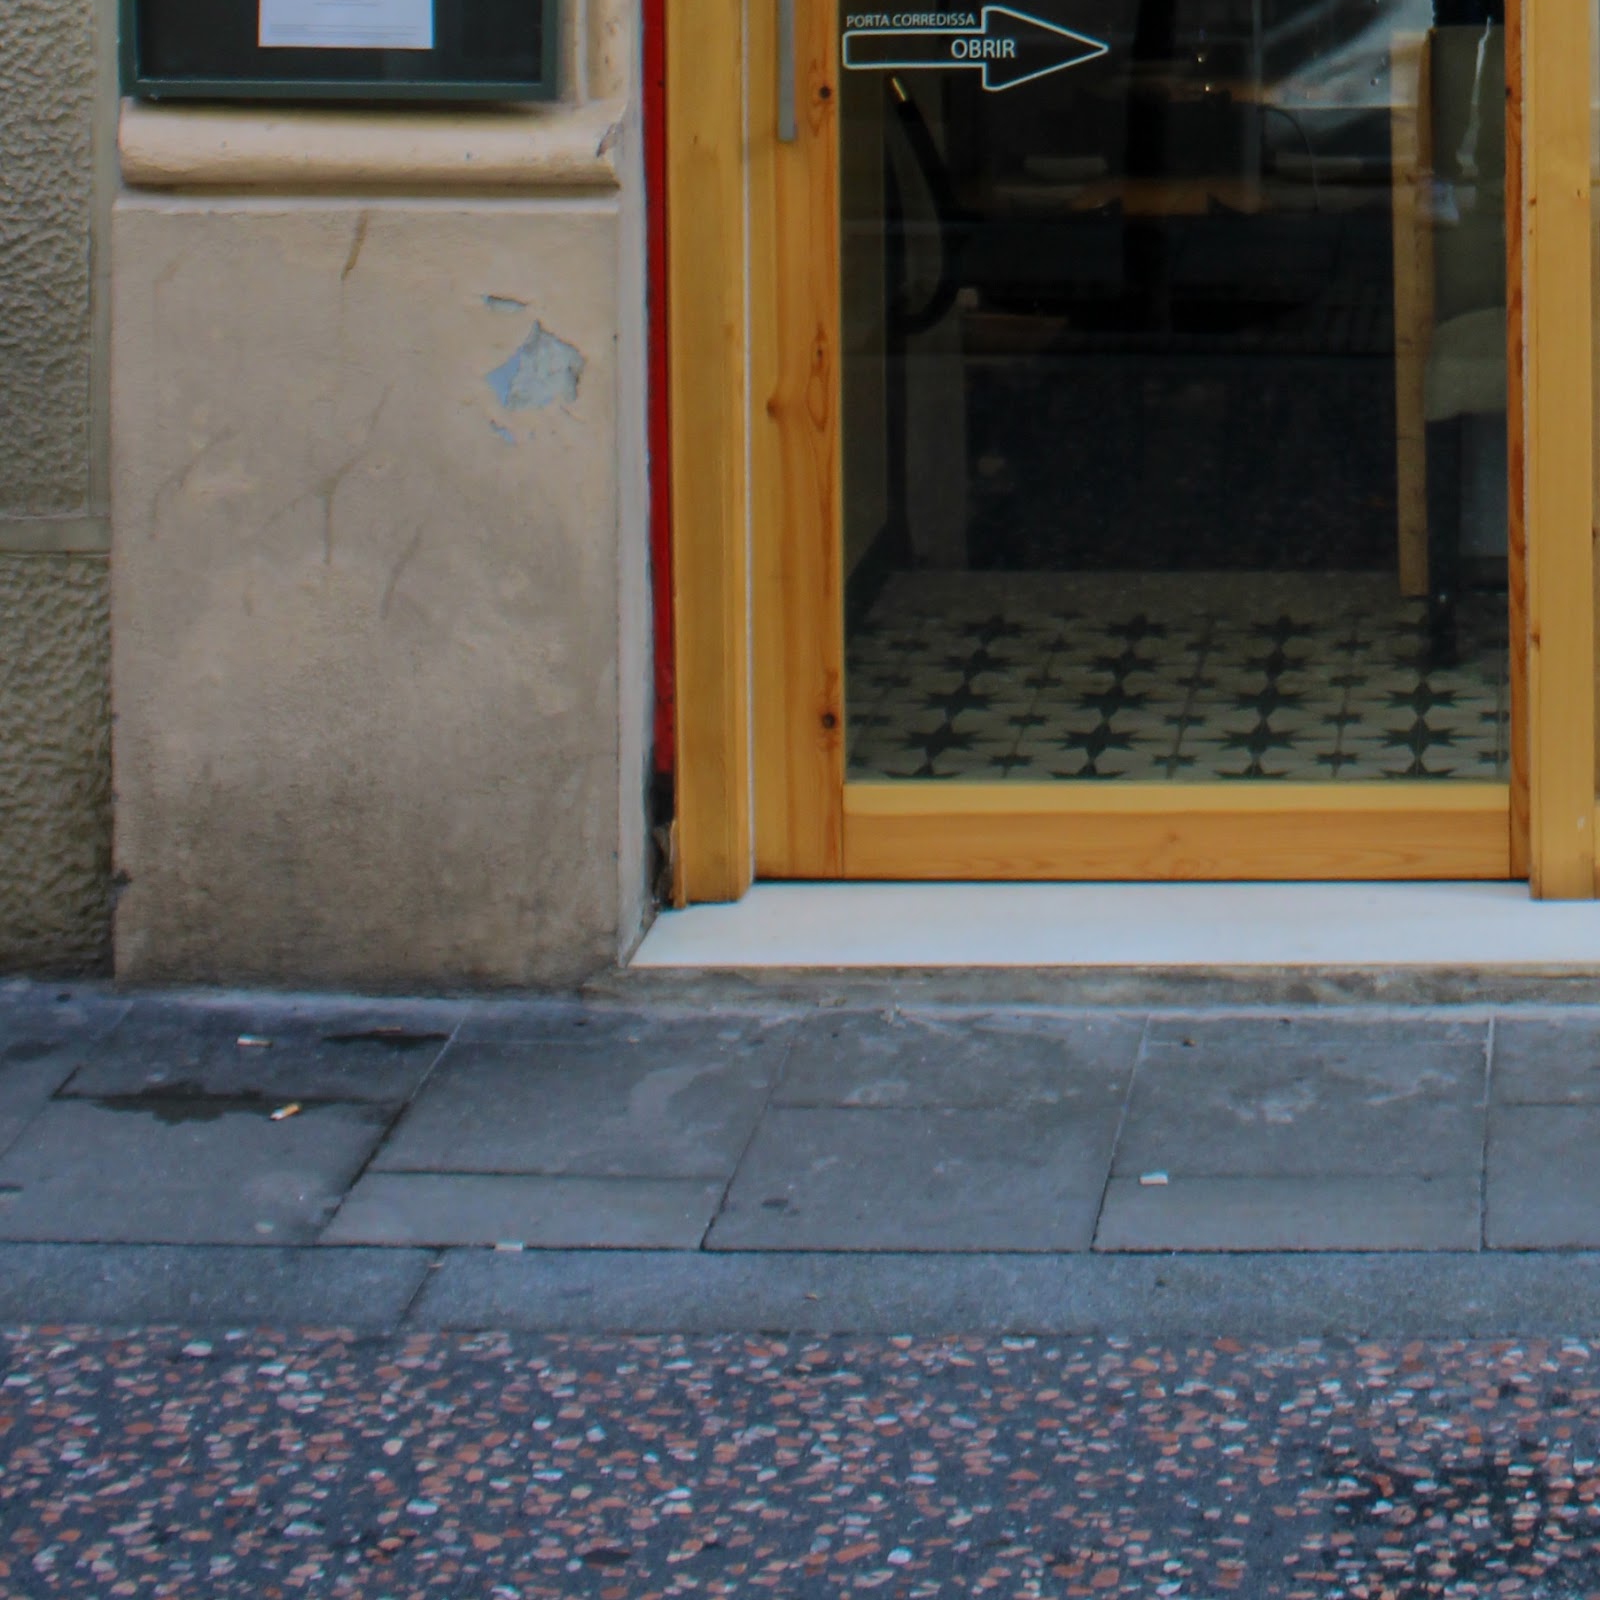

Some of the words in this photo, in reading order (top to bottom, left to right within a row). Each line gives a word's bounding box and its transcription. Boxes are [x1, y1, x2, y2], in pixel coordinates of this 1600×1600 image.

[846, 14, 890, 28] PORTA
[892, 13, 975, 27] CORREDISSA
[951, 39, 1015, 59] OBRIR
